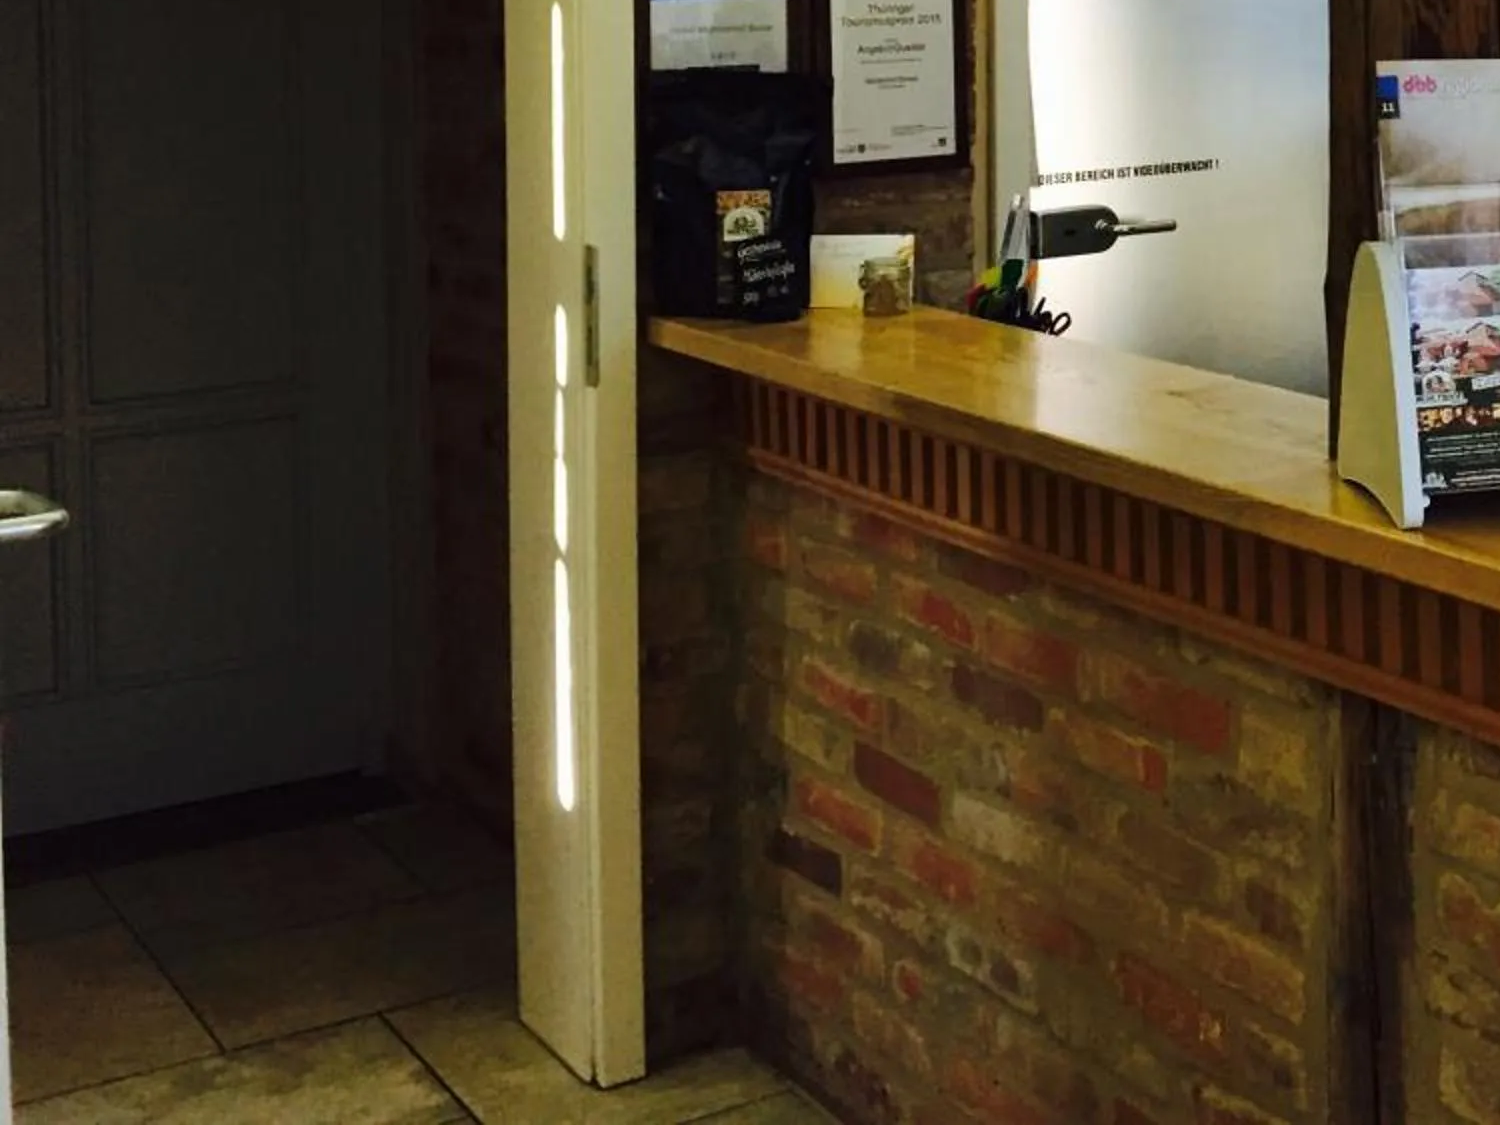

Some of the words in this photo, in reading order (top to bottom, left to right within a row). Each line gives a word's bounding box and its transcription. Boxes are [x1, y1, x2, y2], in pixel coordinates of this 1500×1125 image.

[1037, 173, 1072, 187] DIESER
[1075, 169, 1114, 182] BEREICH
[1116, 167, 1131, 179] IST
